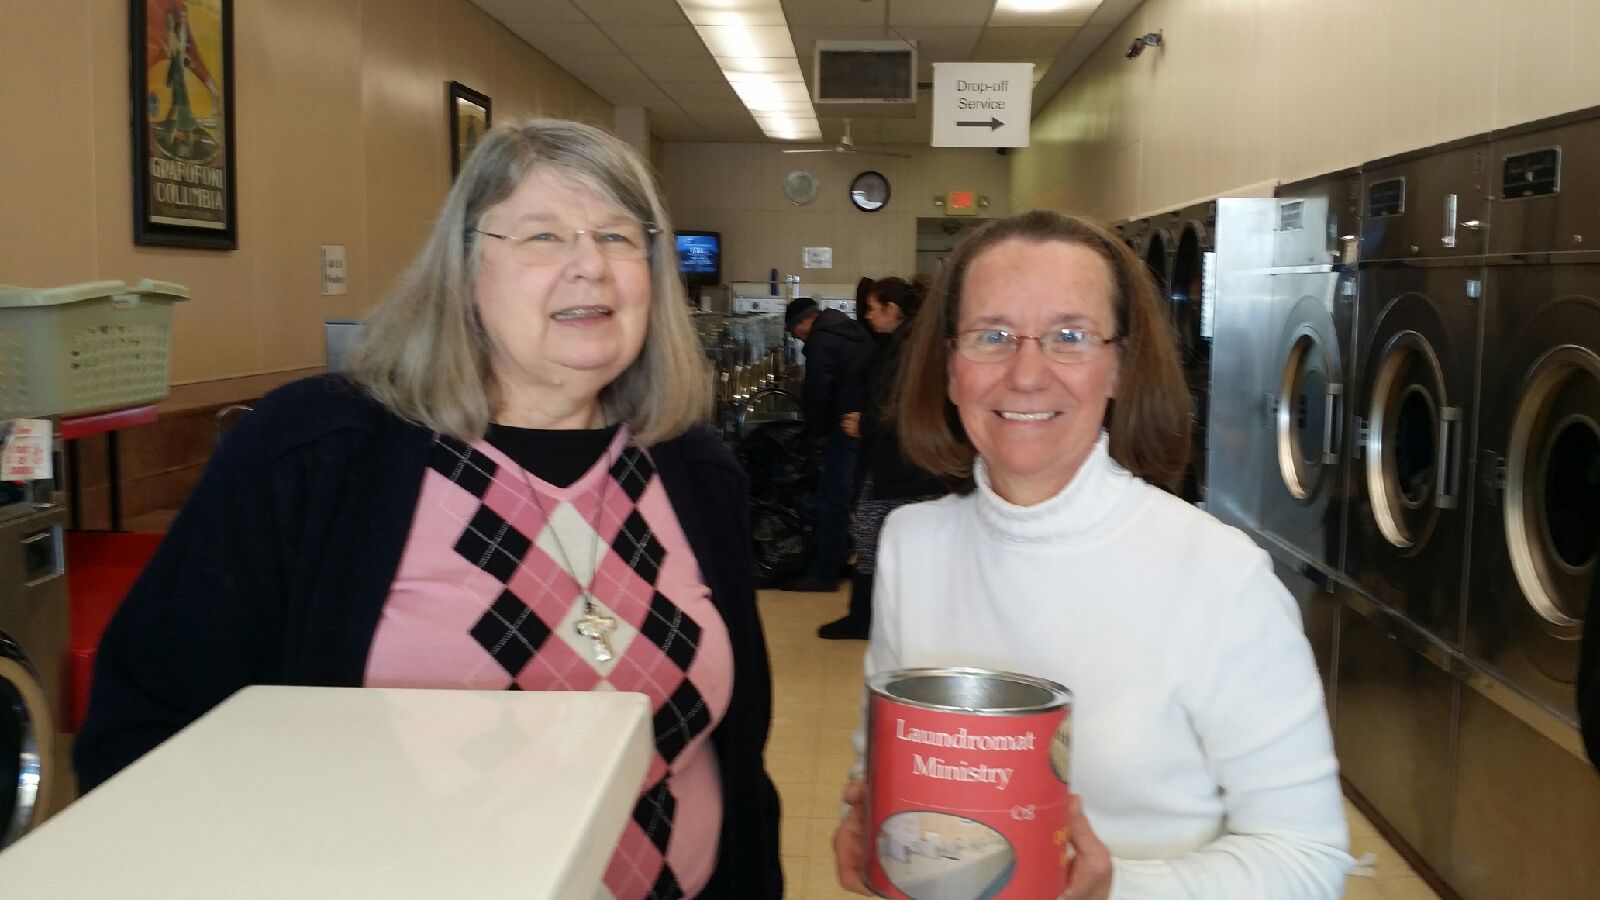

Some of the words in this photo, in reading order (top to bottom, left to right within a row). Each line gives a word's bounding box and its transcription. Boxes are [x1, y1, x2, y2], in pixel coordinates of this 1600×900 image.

[956, 79, 1009, 94] Drop-off
[957, 97, 1006, 110] Service
[156, 182, 224, 210] COLUMBIA
[896, 718, 1036, 750] Laundromat
[912, 753, 1013, 790] Ministry
